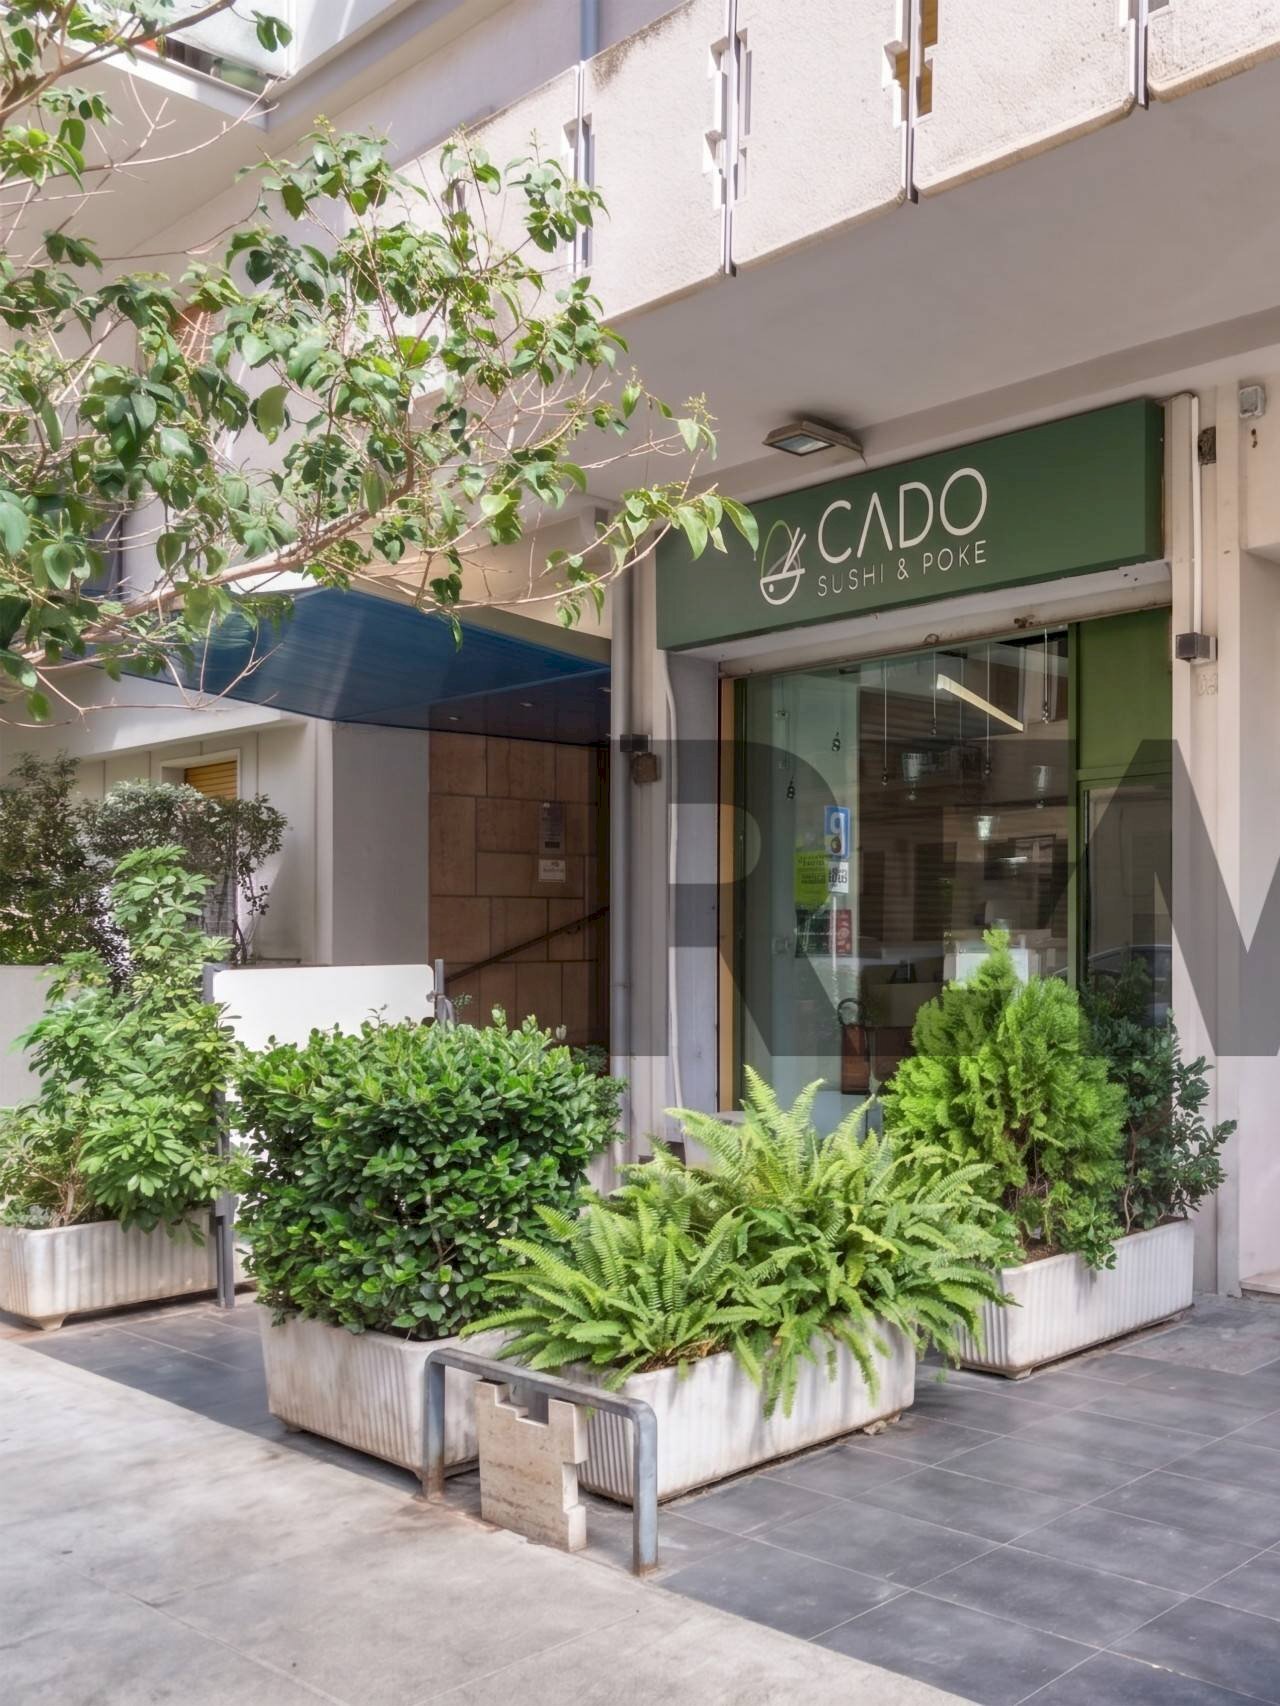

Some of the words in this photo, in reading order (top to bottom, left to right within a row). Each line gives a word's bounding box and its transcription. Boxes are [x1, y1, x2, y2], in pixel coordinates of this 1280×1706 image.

[817, 467, 988, 564] CADO
[817, 563, 884, 597] SUSHI
[896, 557, 910, 581] &
[922, 539, 988, 575] POKE
